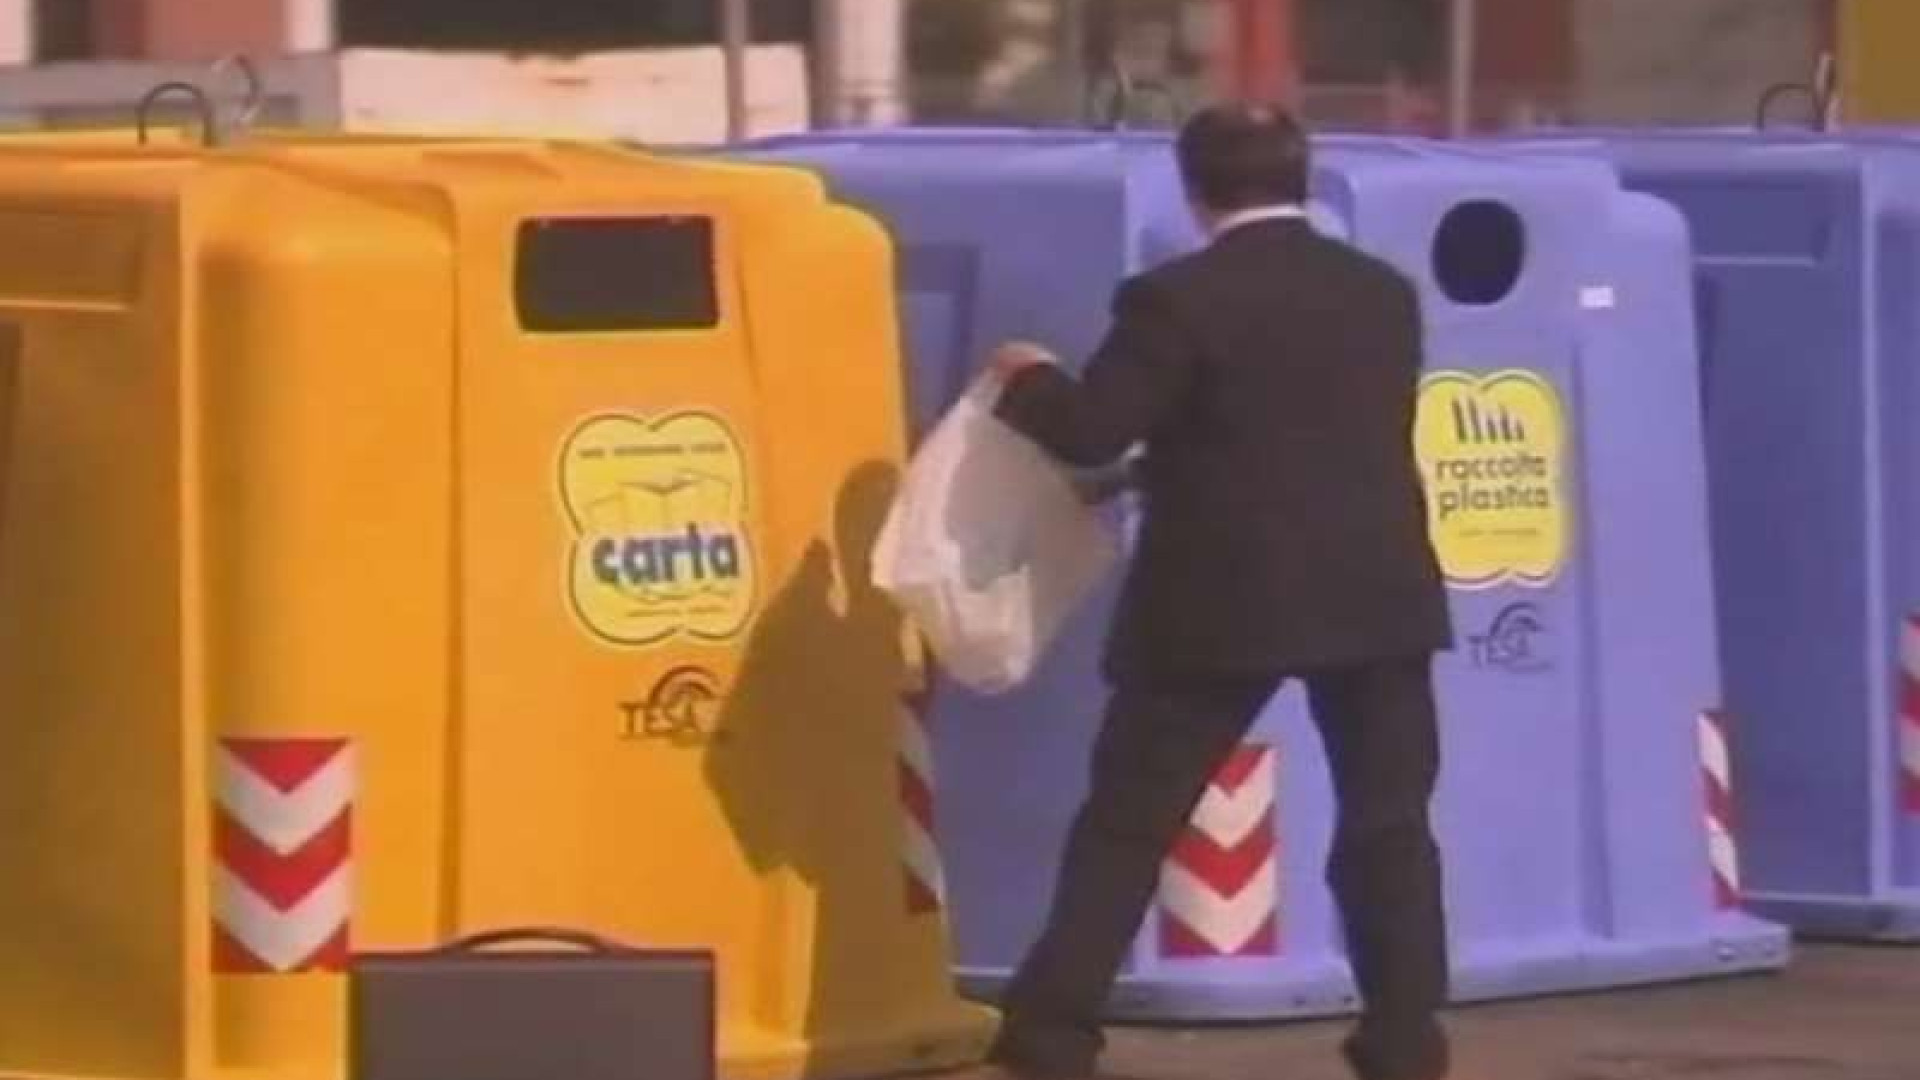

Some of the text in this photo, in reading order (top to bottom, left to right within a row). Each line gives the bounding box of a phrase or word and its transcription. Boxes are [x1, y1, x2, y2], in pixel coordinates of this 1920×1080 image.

[1435, 452, 1547, 481] raccolta
[1438, 481, 1549, 520] plastica
[592, 522, 739, 585] carta
